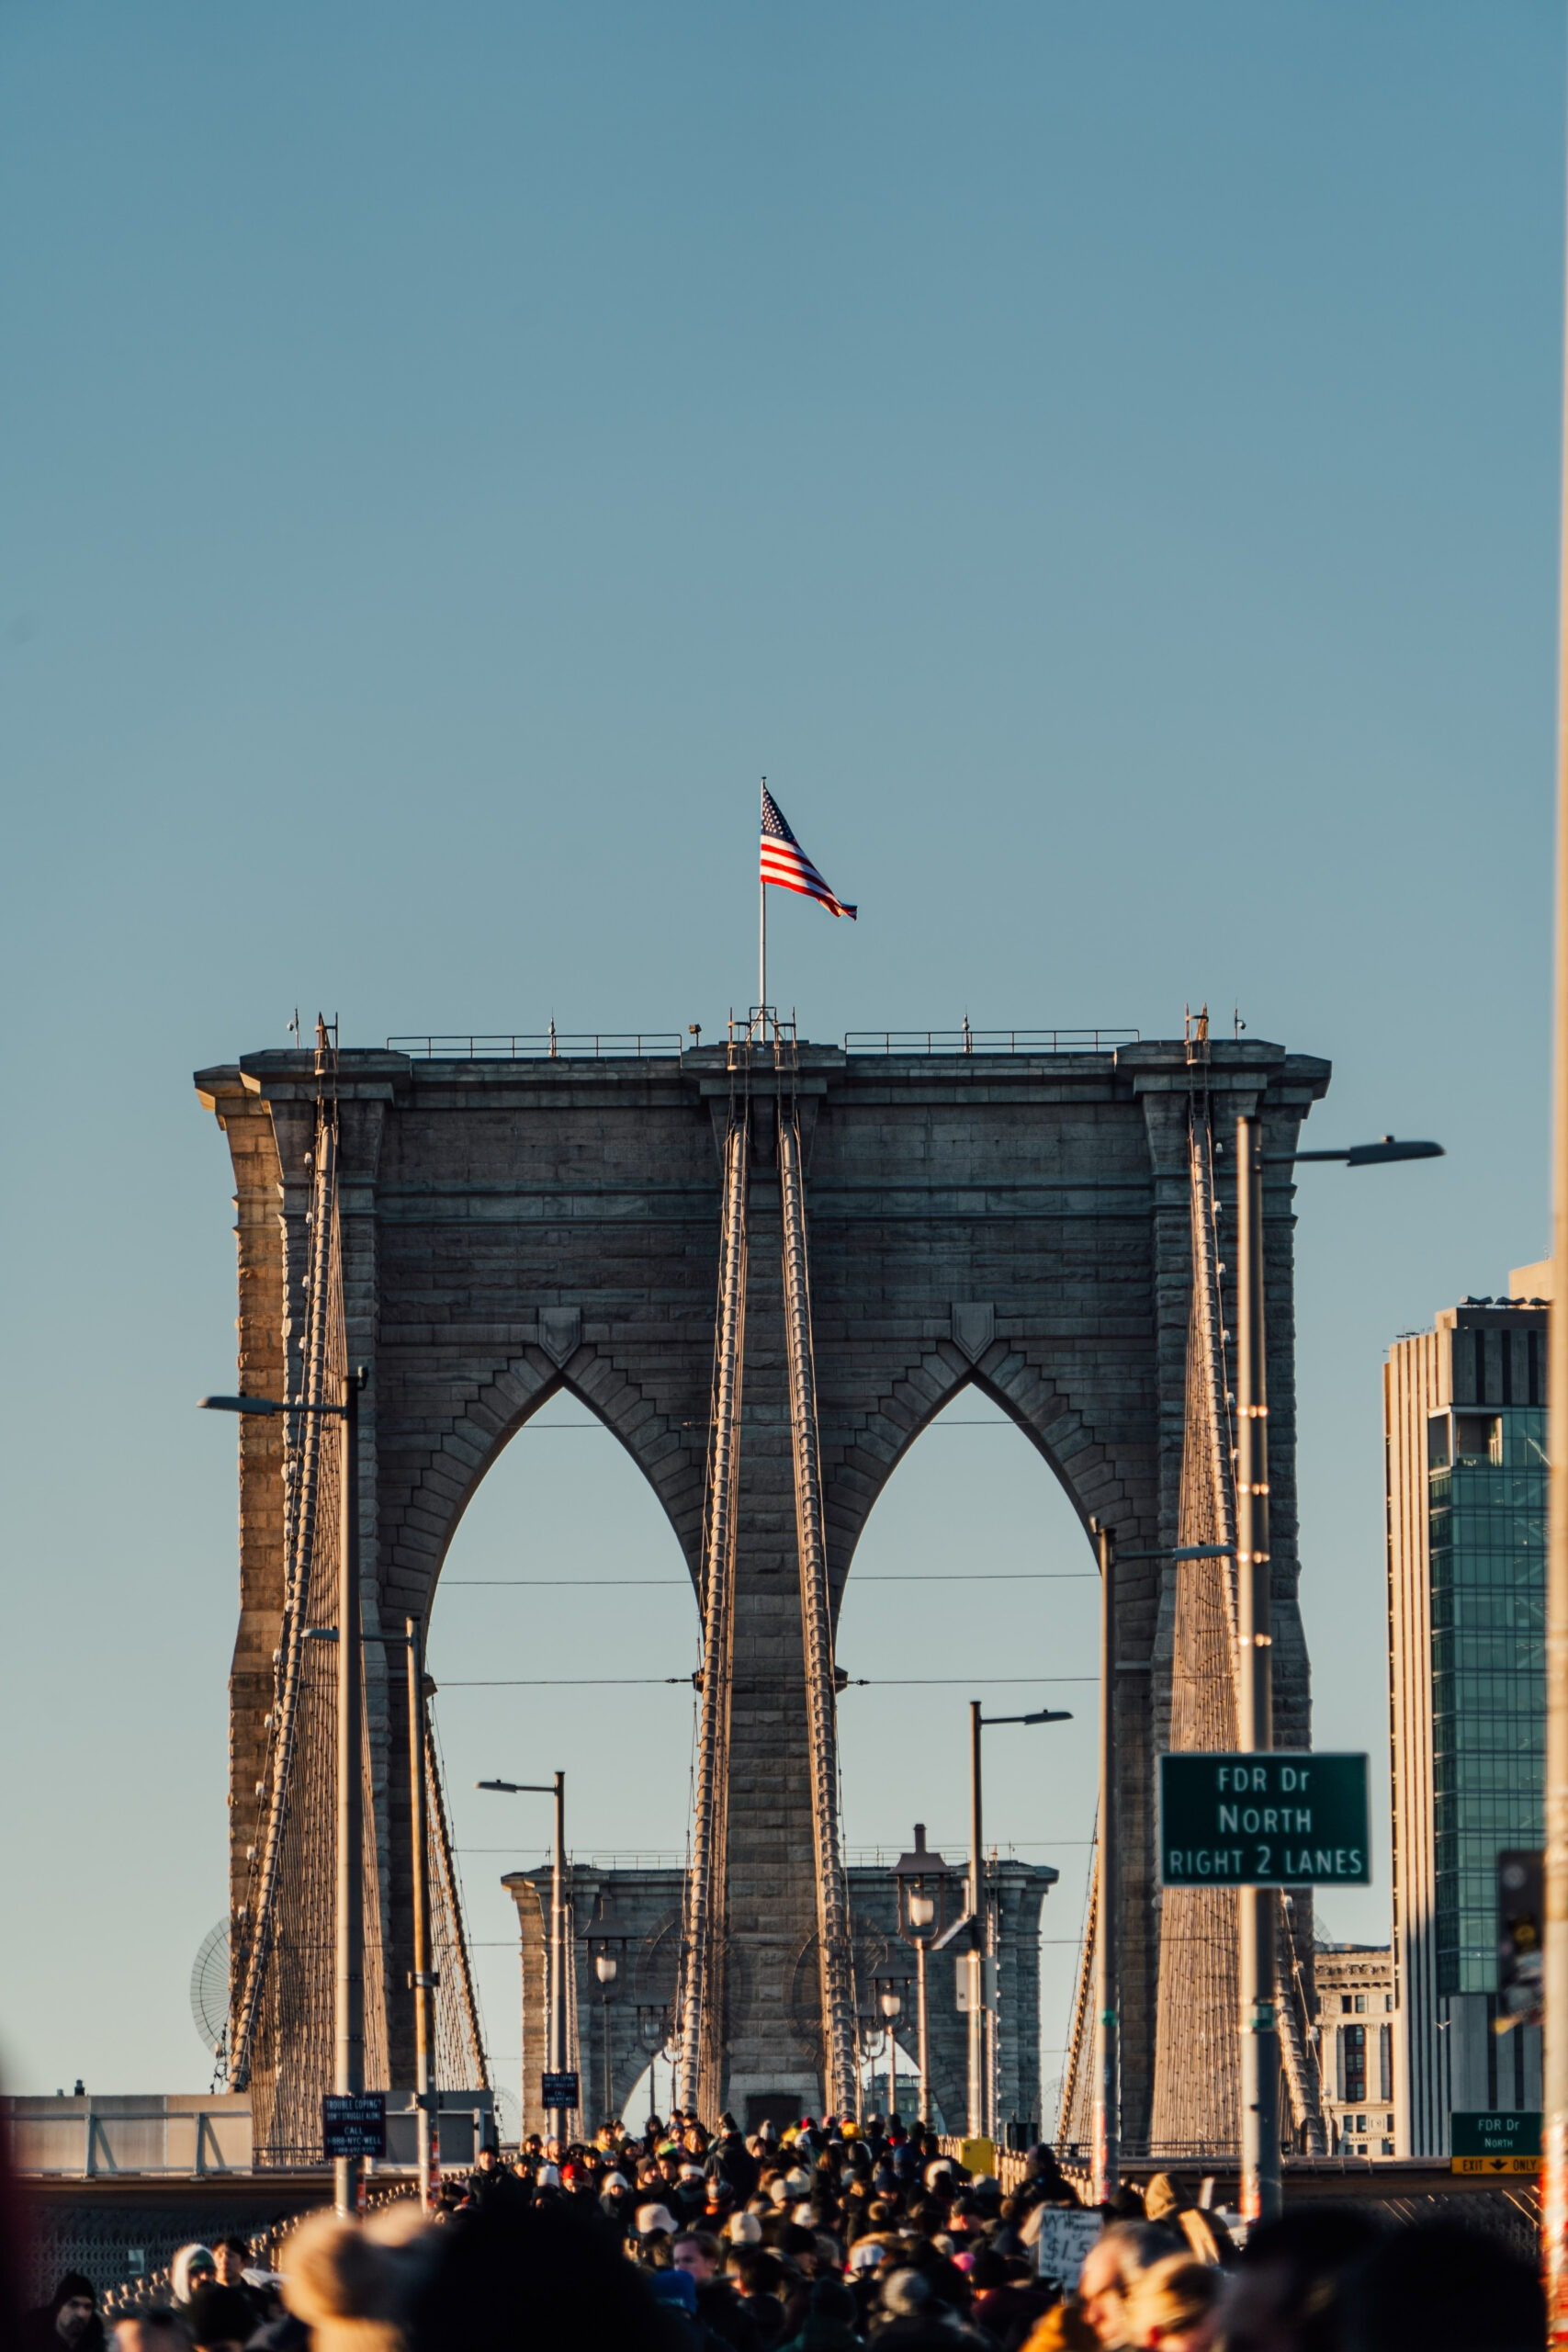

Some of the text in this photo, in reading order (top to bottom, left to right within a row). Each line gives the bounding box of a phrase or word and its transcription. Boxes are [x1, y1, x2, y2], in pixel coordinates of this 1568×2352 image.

[1217, 1767, 1311, 1792] FDR Dr
[1219, 1804, 1313, 1834] NORTH
[1169, 1845, 1363, 1875] RIGHT 2 LANES
[344, 2126, 364, 2135] CALL
[1477, 2119, 1520, 2132] FDR Dr
[1483, 2138, 1514, 2148] NORTH
[1461, 2159, 1537, 2172] EXIT ONLY
